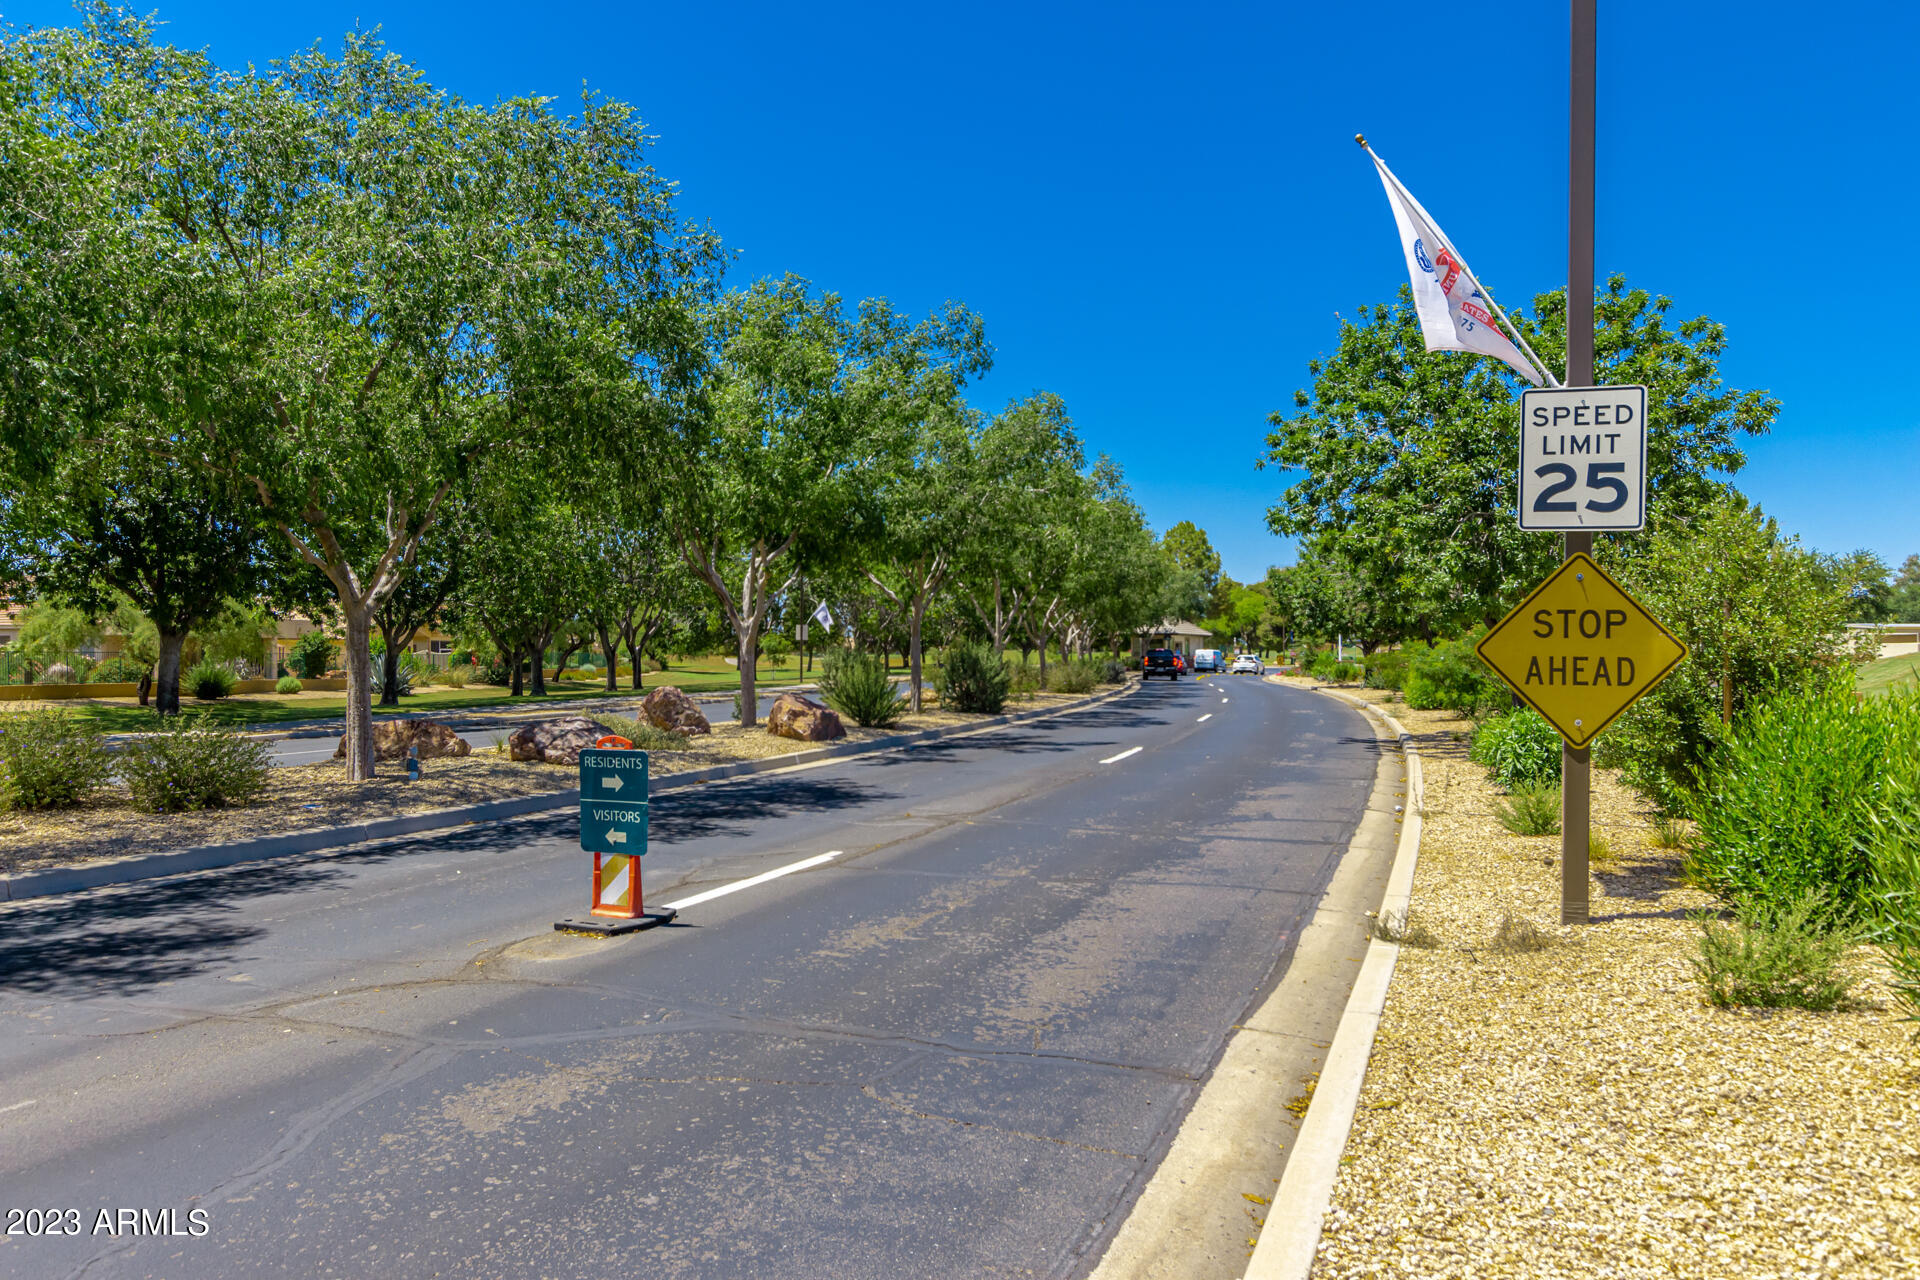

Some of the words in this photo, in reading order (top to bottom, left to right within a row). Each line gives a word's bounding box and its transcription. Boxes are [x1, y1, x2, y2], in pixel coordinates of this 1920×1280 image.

[1463, 304, 1489, 323] ATES
[1461, 317, 1475, 332] 75
[1532, 404, 1634, 427] SPEED
[1542, 434, 1621, 455] LIMIT
[1533, 462, 1629, 513] 25
[1532, 609, 1628, 640] STOP
[1524, 655, 1636, 687] AHEAD
[584, 756, 642, 769] RESIDENTS
[593, 809, 640, 823] VISITORS
